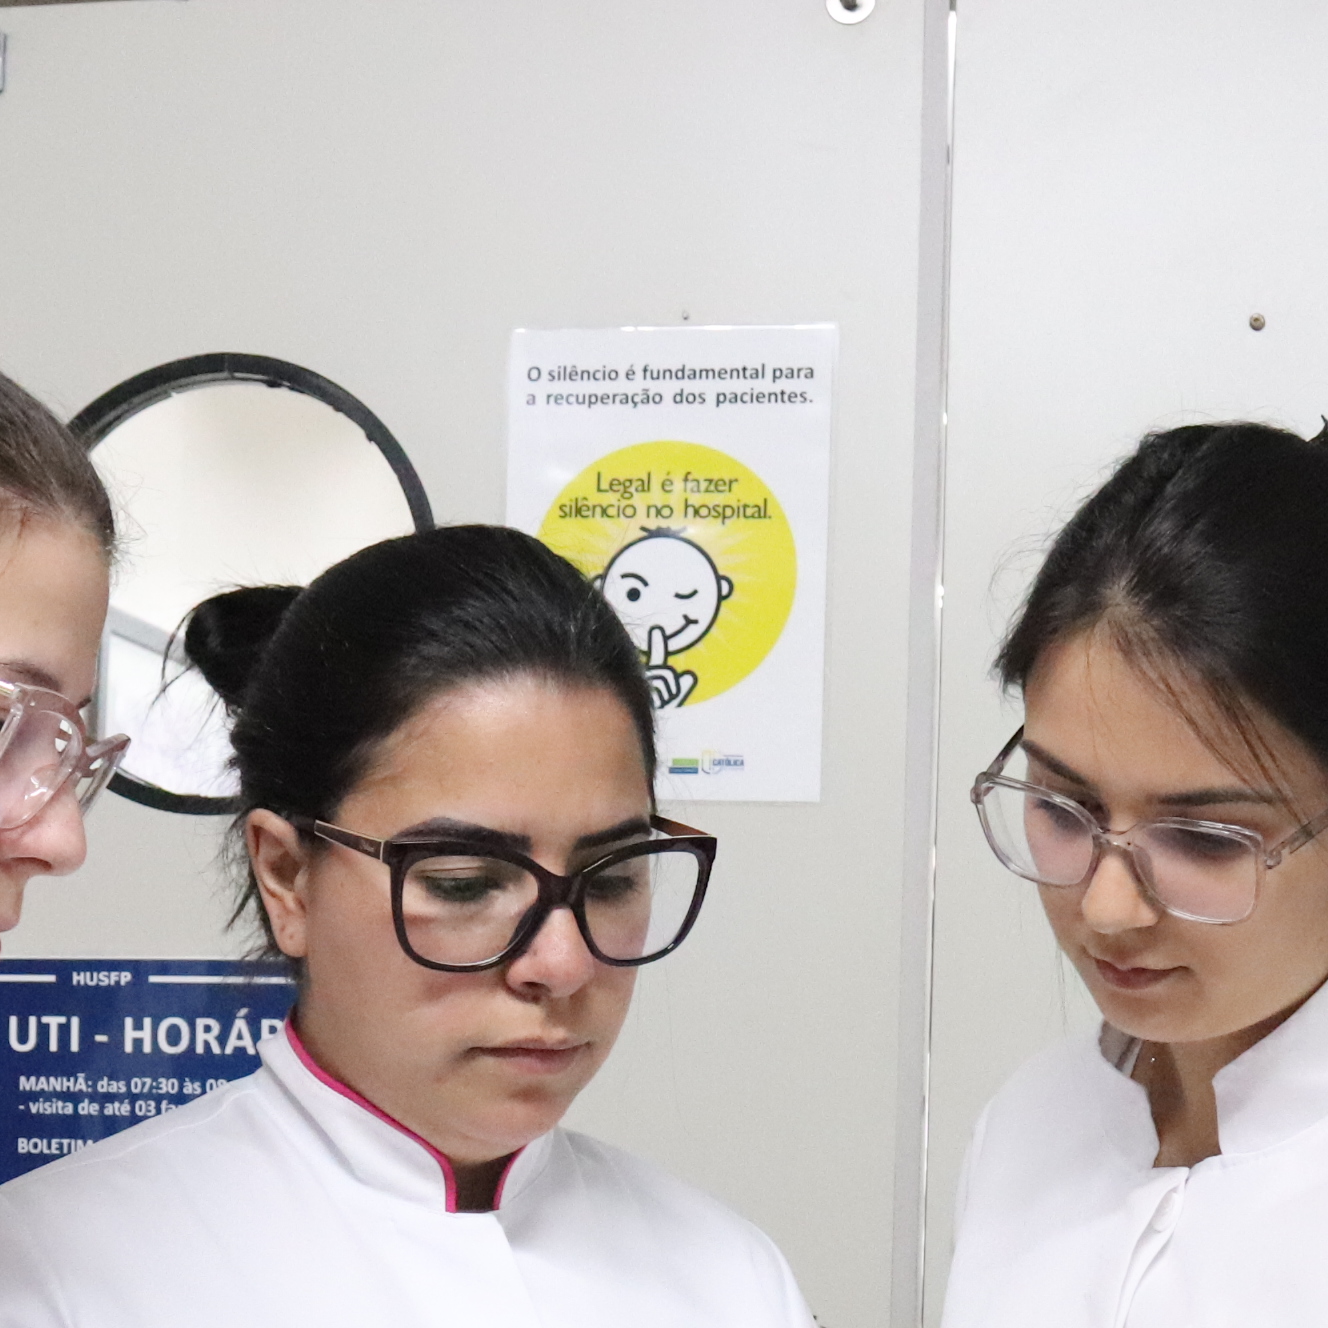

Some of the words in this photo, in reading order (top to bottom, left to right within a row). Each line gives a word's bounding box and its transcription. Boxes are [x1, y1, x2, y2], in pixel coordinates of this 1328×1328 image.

[527, 366, 541, 381] O
[548, 365, 619, 381] silêncio
[625, 364, 636, 381] é
[642, 363, 765, 381] fundamental
[772, 366, 814, 383] para
[526, 394, 536, 405] a
[546, 388, 663, 409] recuperação
[673, 388, 706, 405] dos
[715, 387, 813, 408] pacientes.
[596, 471, 651, 500] Legal
[661, 472, 673, 493] é
[683, 471, 738, 493] fazer
[558, 497, 637, 519] silêncio
[646, 504, 674, 519] no
[684, 498, 772, 525] hospital.
[72, 971, 132, 987] HUSFP
[8, 1015, 80, 1053] UTI
[19, 1073, 92, 1092] MANHÃ:
[97, 1076, 126, 1093] das
[131, 1078, 178, 1094] 07:30
[183, 1078, 201, 1095] às
[29, 1098, 74, 1114] visita
[78, 1099, 99, 1115] de
[104, 1100, 130, 1116] até
[135, 1101, 156, 1116] 03
